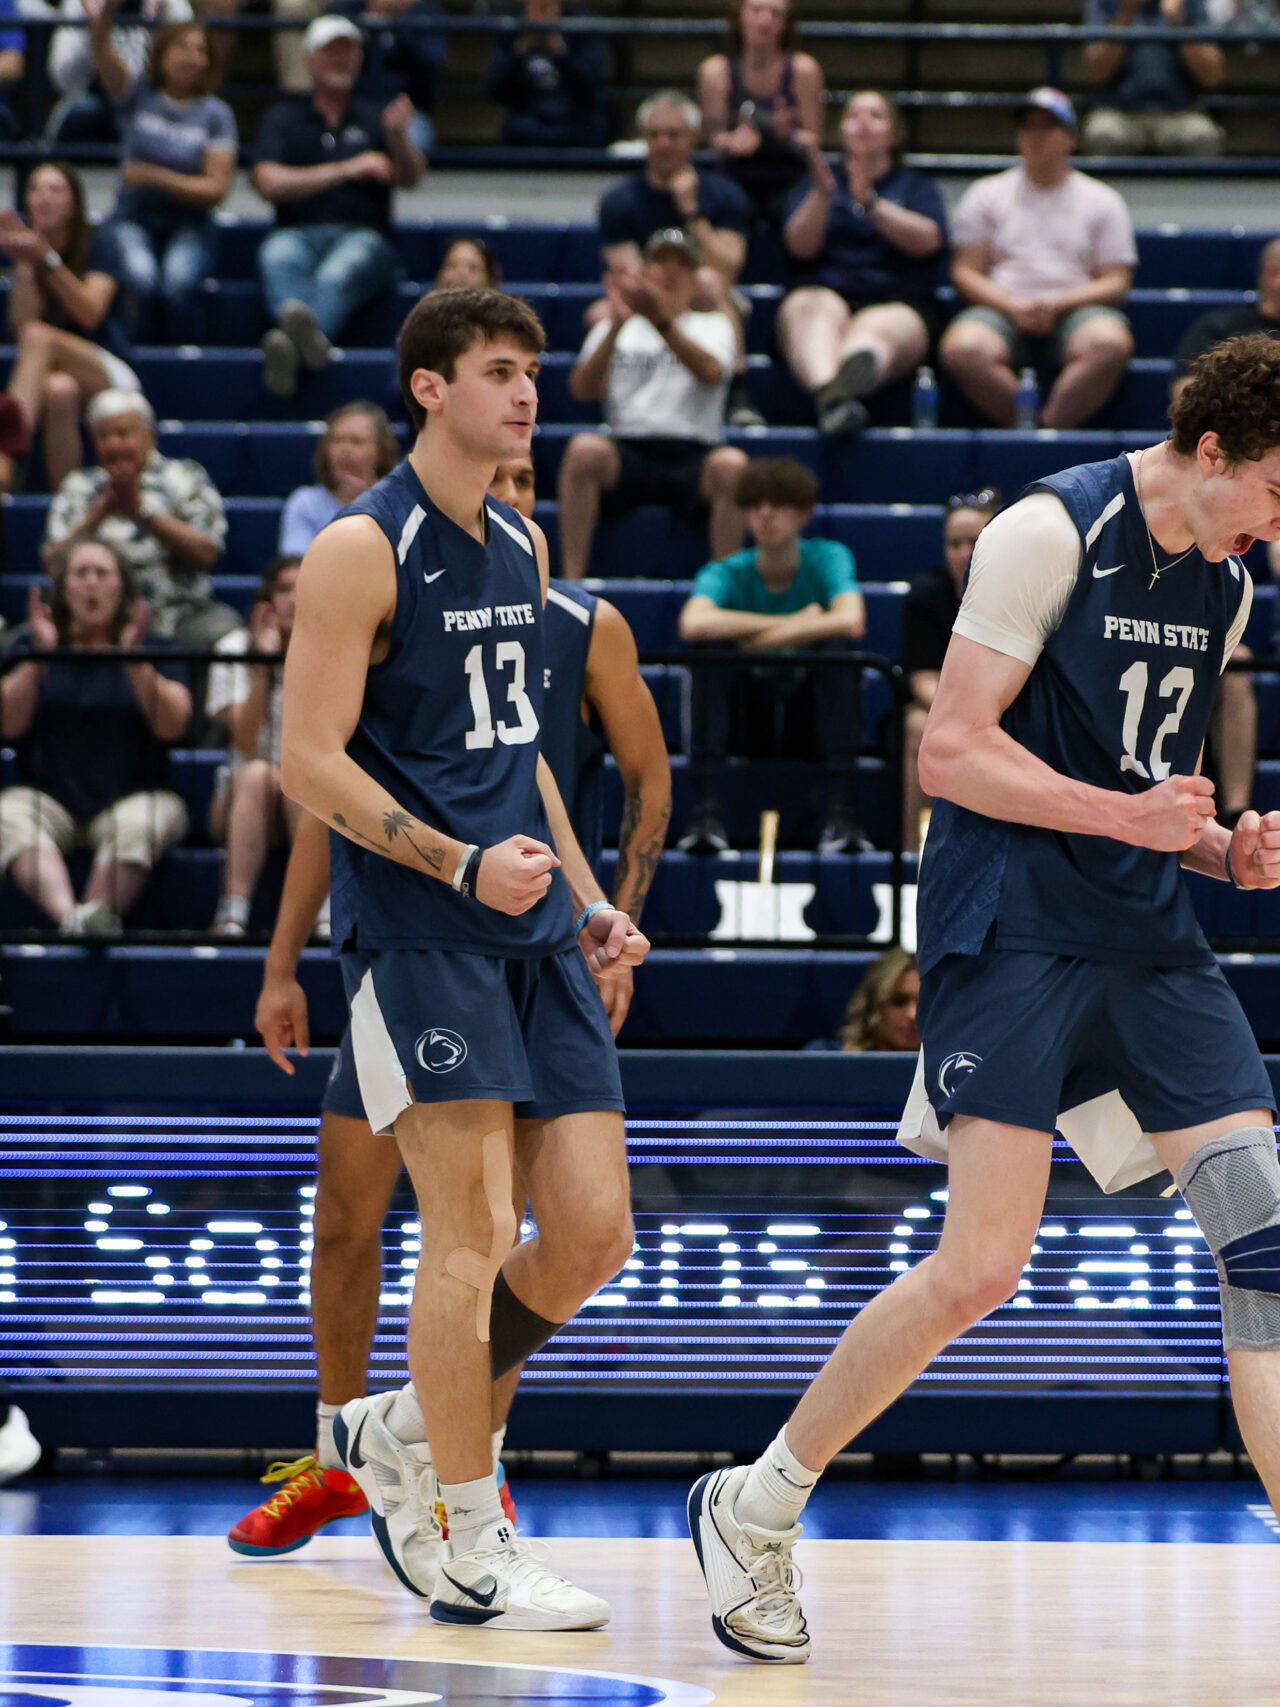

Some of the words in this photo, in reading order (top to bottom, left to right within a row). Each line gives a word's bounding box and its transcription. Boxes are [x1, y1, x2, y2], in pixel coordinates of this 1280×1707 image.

[443, 607, 492, 632] PENN
[1103, 615, 1161, 645] PENN
[1163, 623, 1210, 652] STATE
[464, 641, 540, 750] 13
[1119, 660, 1195, 782] 12
